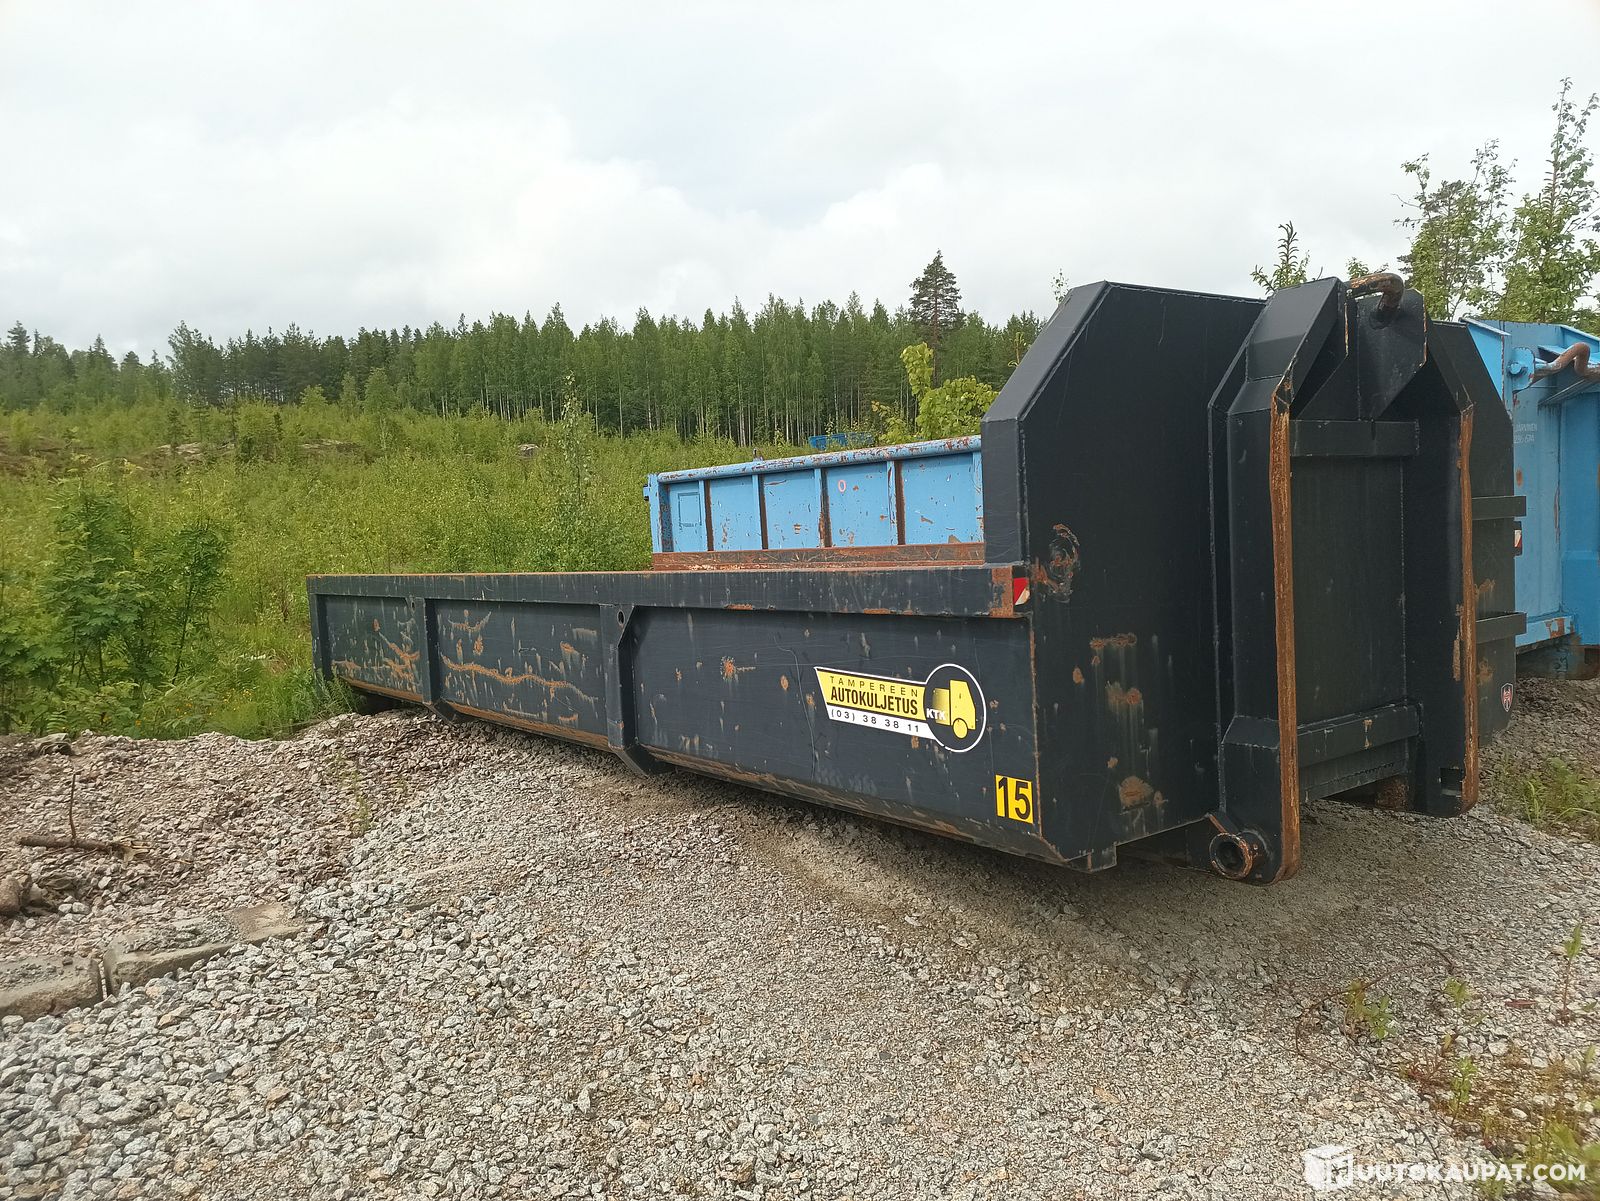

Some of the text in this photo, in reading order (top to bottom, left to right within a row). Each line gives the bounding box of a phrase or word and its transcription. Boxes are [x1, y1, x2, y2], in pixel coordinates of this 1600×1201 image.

[830, 676, 918, 697] TAMPEREEN
[831, 686, 918, 715] AUTOKULJETUS
[831, 709, 919, 732] (03) 38 38 11
[998, 777, 1031, 820] 15
